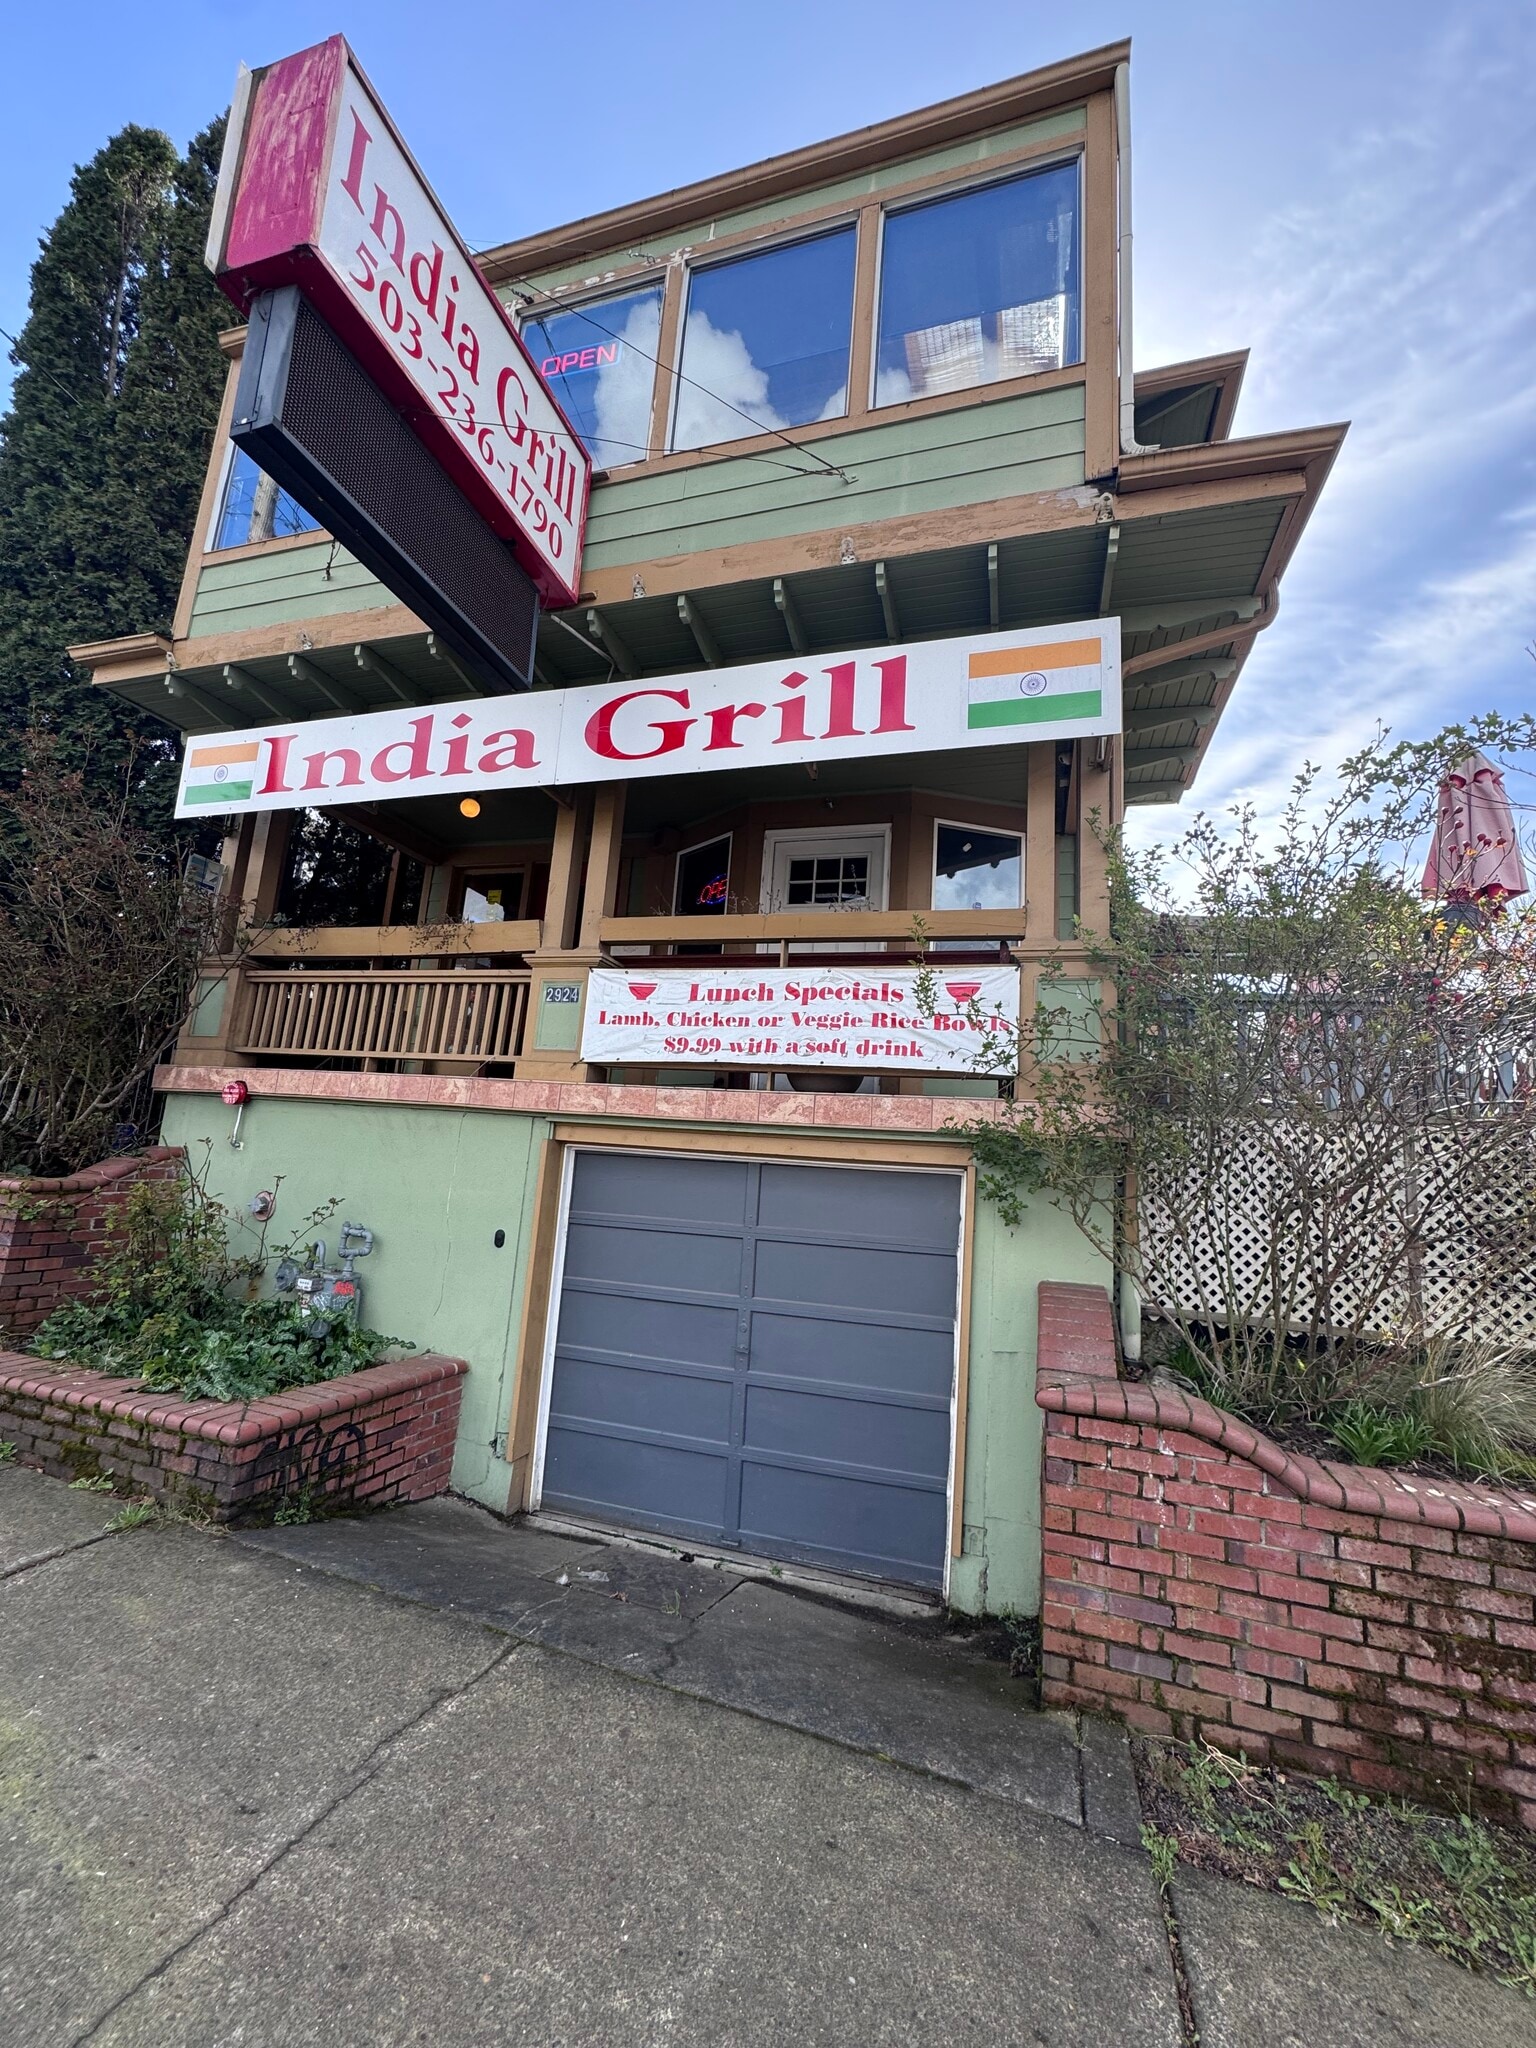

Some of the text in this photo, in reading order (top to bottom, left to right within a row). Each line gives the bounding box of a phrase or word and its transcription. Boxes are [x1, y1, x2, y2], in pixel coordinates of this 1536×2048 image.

[340, 104, 582, 527] India Grill
[541, 342, 616, 376] OPEN
[348, 241, 564, 560] 503-236-1790
[256, 653, 917, 795] India Grill
[701, 879, 728, 903] OPE
[546, 987, 578, 1002] 2924
[689, 981, 904, 1006] Lunch Specials
[599, 1010, 1010, 1032] Lamb, Chicken or Veggie Rice Bowls
[664, 1036, 924, 1057] $9.99 with a soft drink
